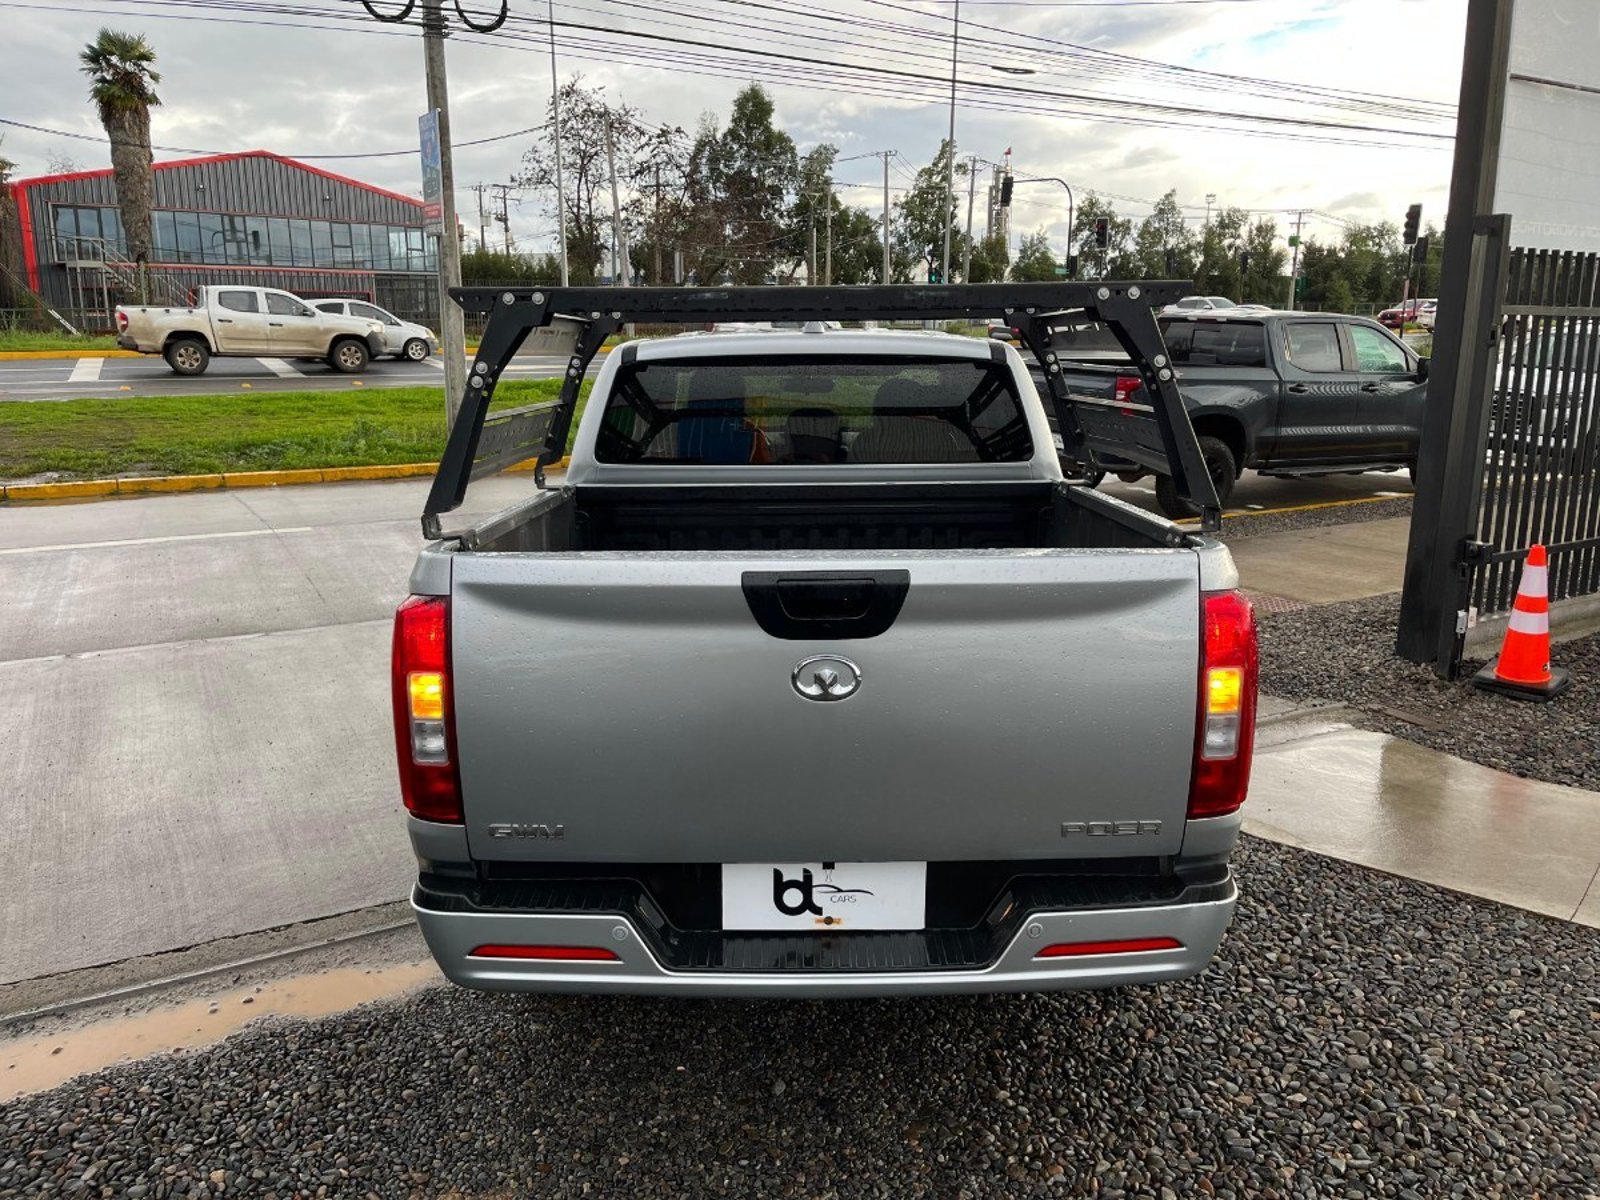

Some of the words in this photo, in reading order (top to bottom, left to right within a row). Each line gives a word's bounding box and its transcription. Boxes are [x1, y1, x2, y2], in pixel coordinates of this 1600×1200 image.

[488, 823, 564, 840] GWM
[1061, 820, 1163, 838] POER
[830, 894, 857, 904] CARS
